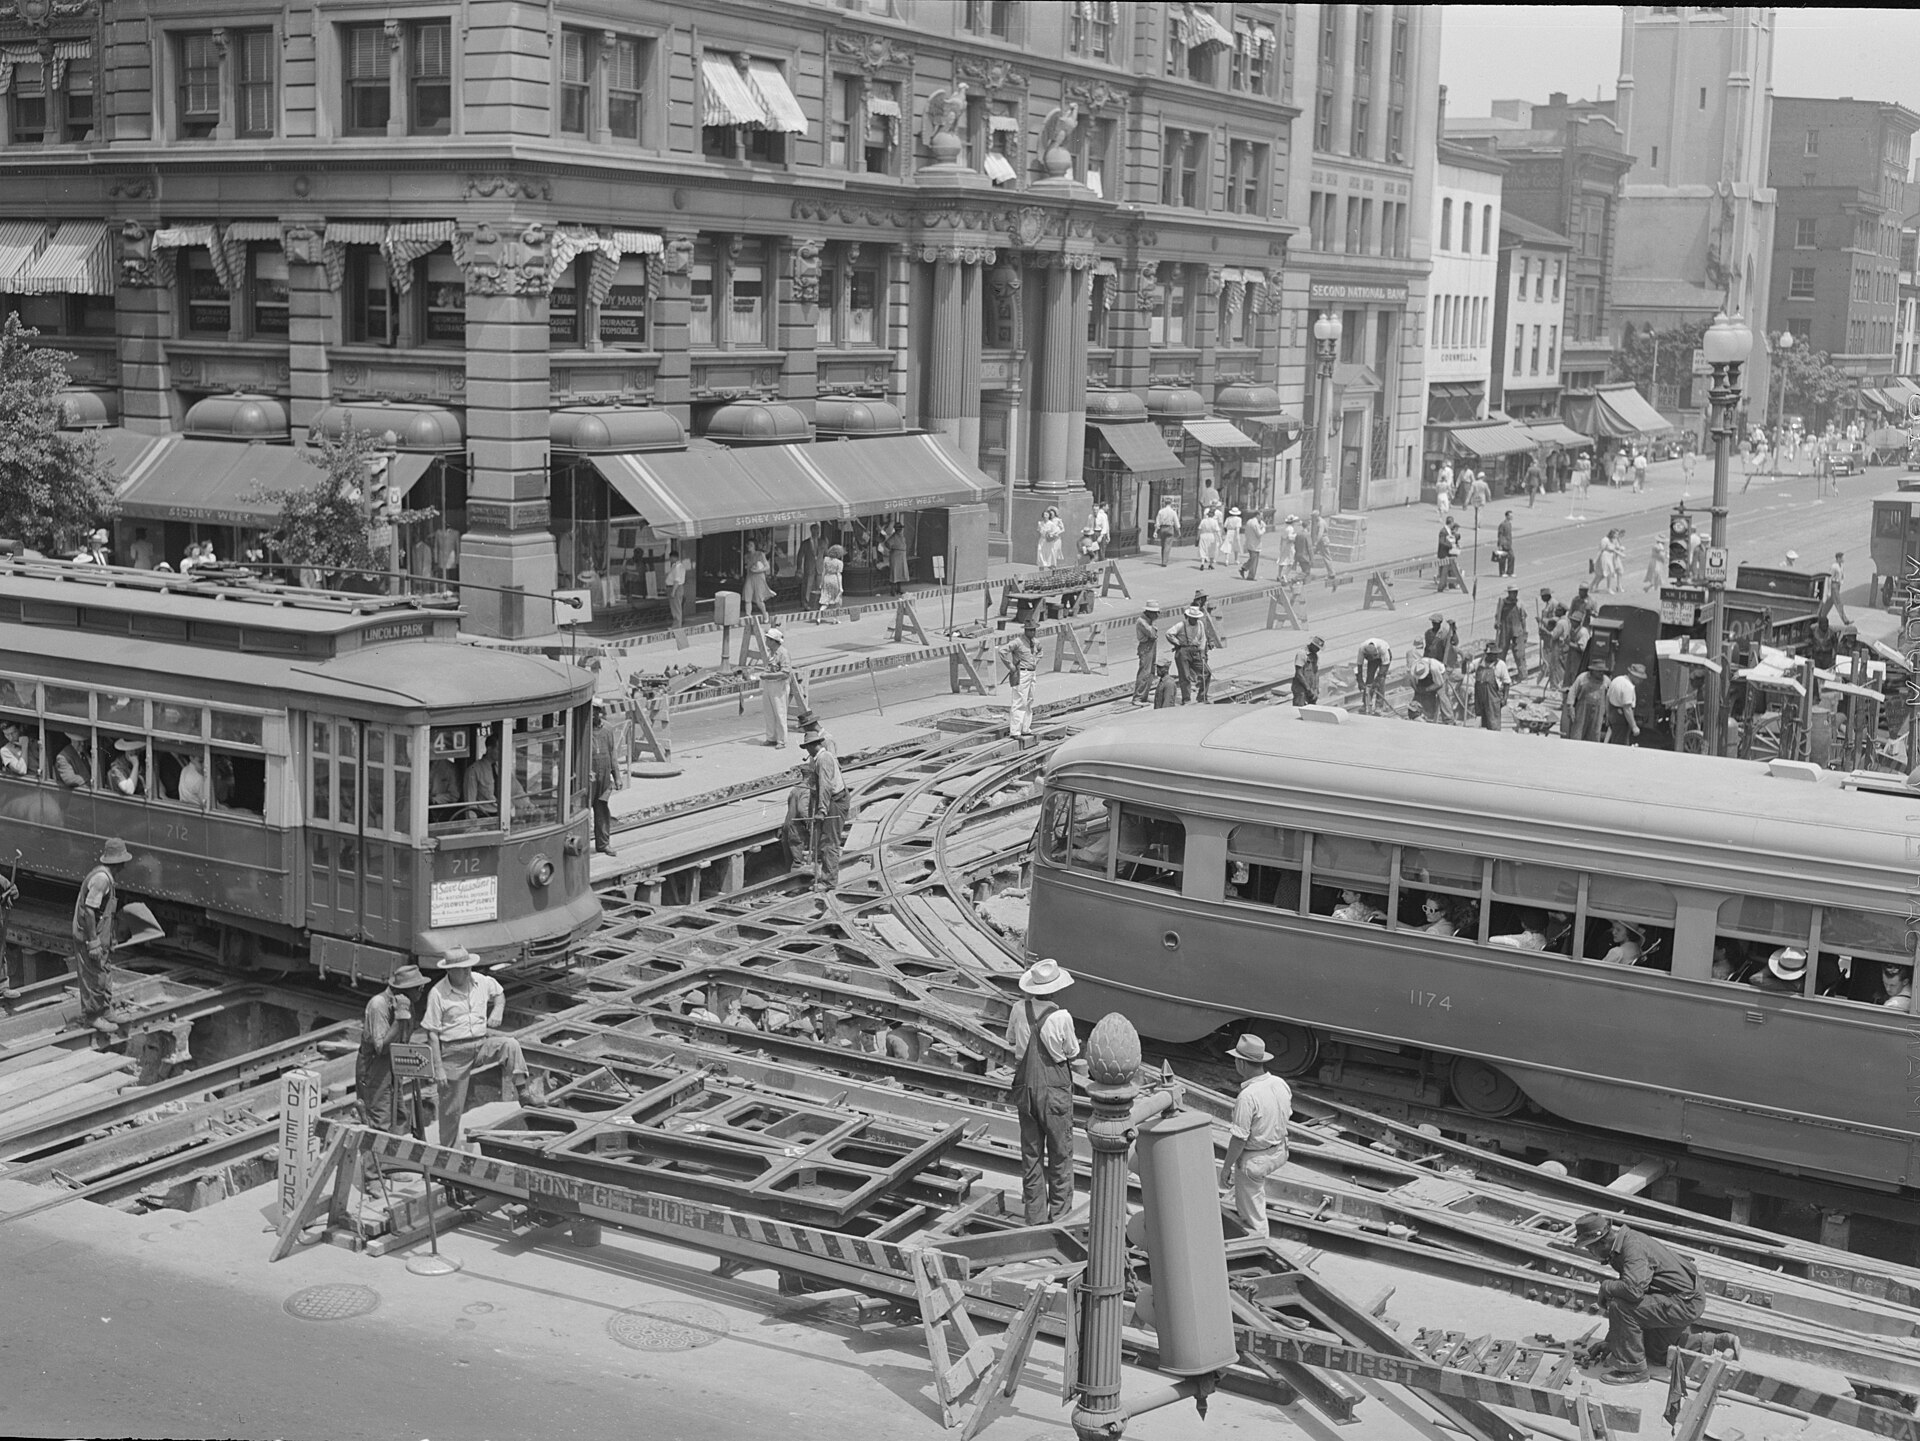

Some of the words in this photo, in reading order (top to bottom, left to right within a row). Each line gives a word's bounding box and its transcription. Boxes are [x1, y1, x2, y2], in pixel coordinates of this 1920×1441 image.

[1312, 284, 1346, 298] SECOND
[1347, 286, 1385, 299] NATIONAL
[1386, 288, 1407, 299] BANK
[618, 295, 644, 306] MARK
[884, 499, 913, 509] SIDNEY
[916, 495, 936, 505] WEST
[736, 514, 769, 526] SIDNEY
[772, 510, 796, 522] WEST
[1709, 558, 1723, 568] U
[1706, 568, 1725, 576] TURN
[365, 626, 400, 641] LINCOLN
[401, 623, 424, 637] PARK
[434, 731, 466, 751] 40
[167, 824, 188, 840] 712
[453, 858, 480, 874] 712
[1411, 989, 1452, 1011] 1174
[287, 1081, 300, 1107] NO
[308, 1084, 318, 1109] NO
[285, 1110, 298, 1160] LEFT
[282, 1163, 297, 1212] TURN
[1325, 1346, 1419, 1385] FIRST
